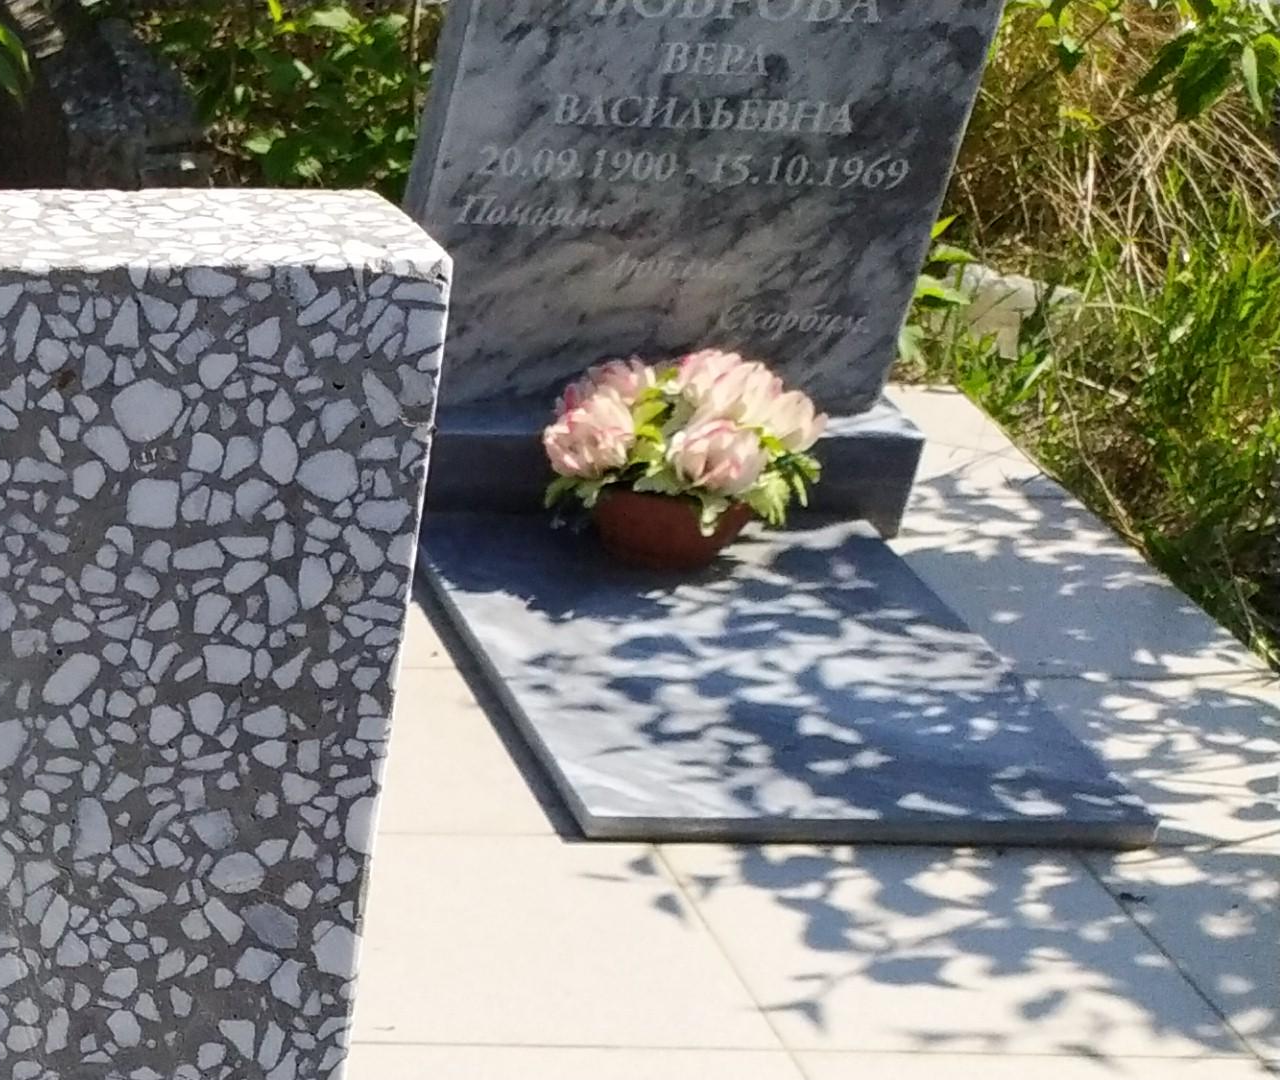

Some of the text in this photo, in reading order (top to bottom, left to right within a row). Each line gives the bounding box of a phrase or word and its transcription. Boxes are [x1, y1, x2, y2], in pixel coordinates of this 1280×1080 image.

[660, 41, 769, 77] ВЕРА
[554, 95, 853, 133] ВАСИЛЬЕВНА
[478, 146, 678, 182] 20.09.1900
[711, 155, 911, 191] 15.10.1969
